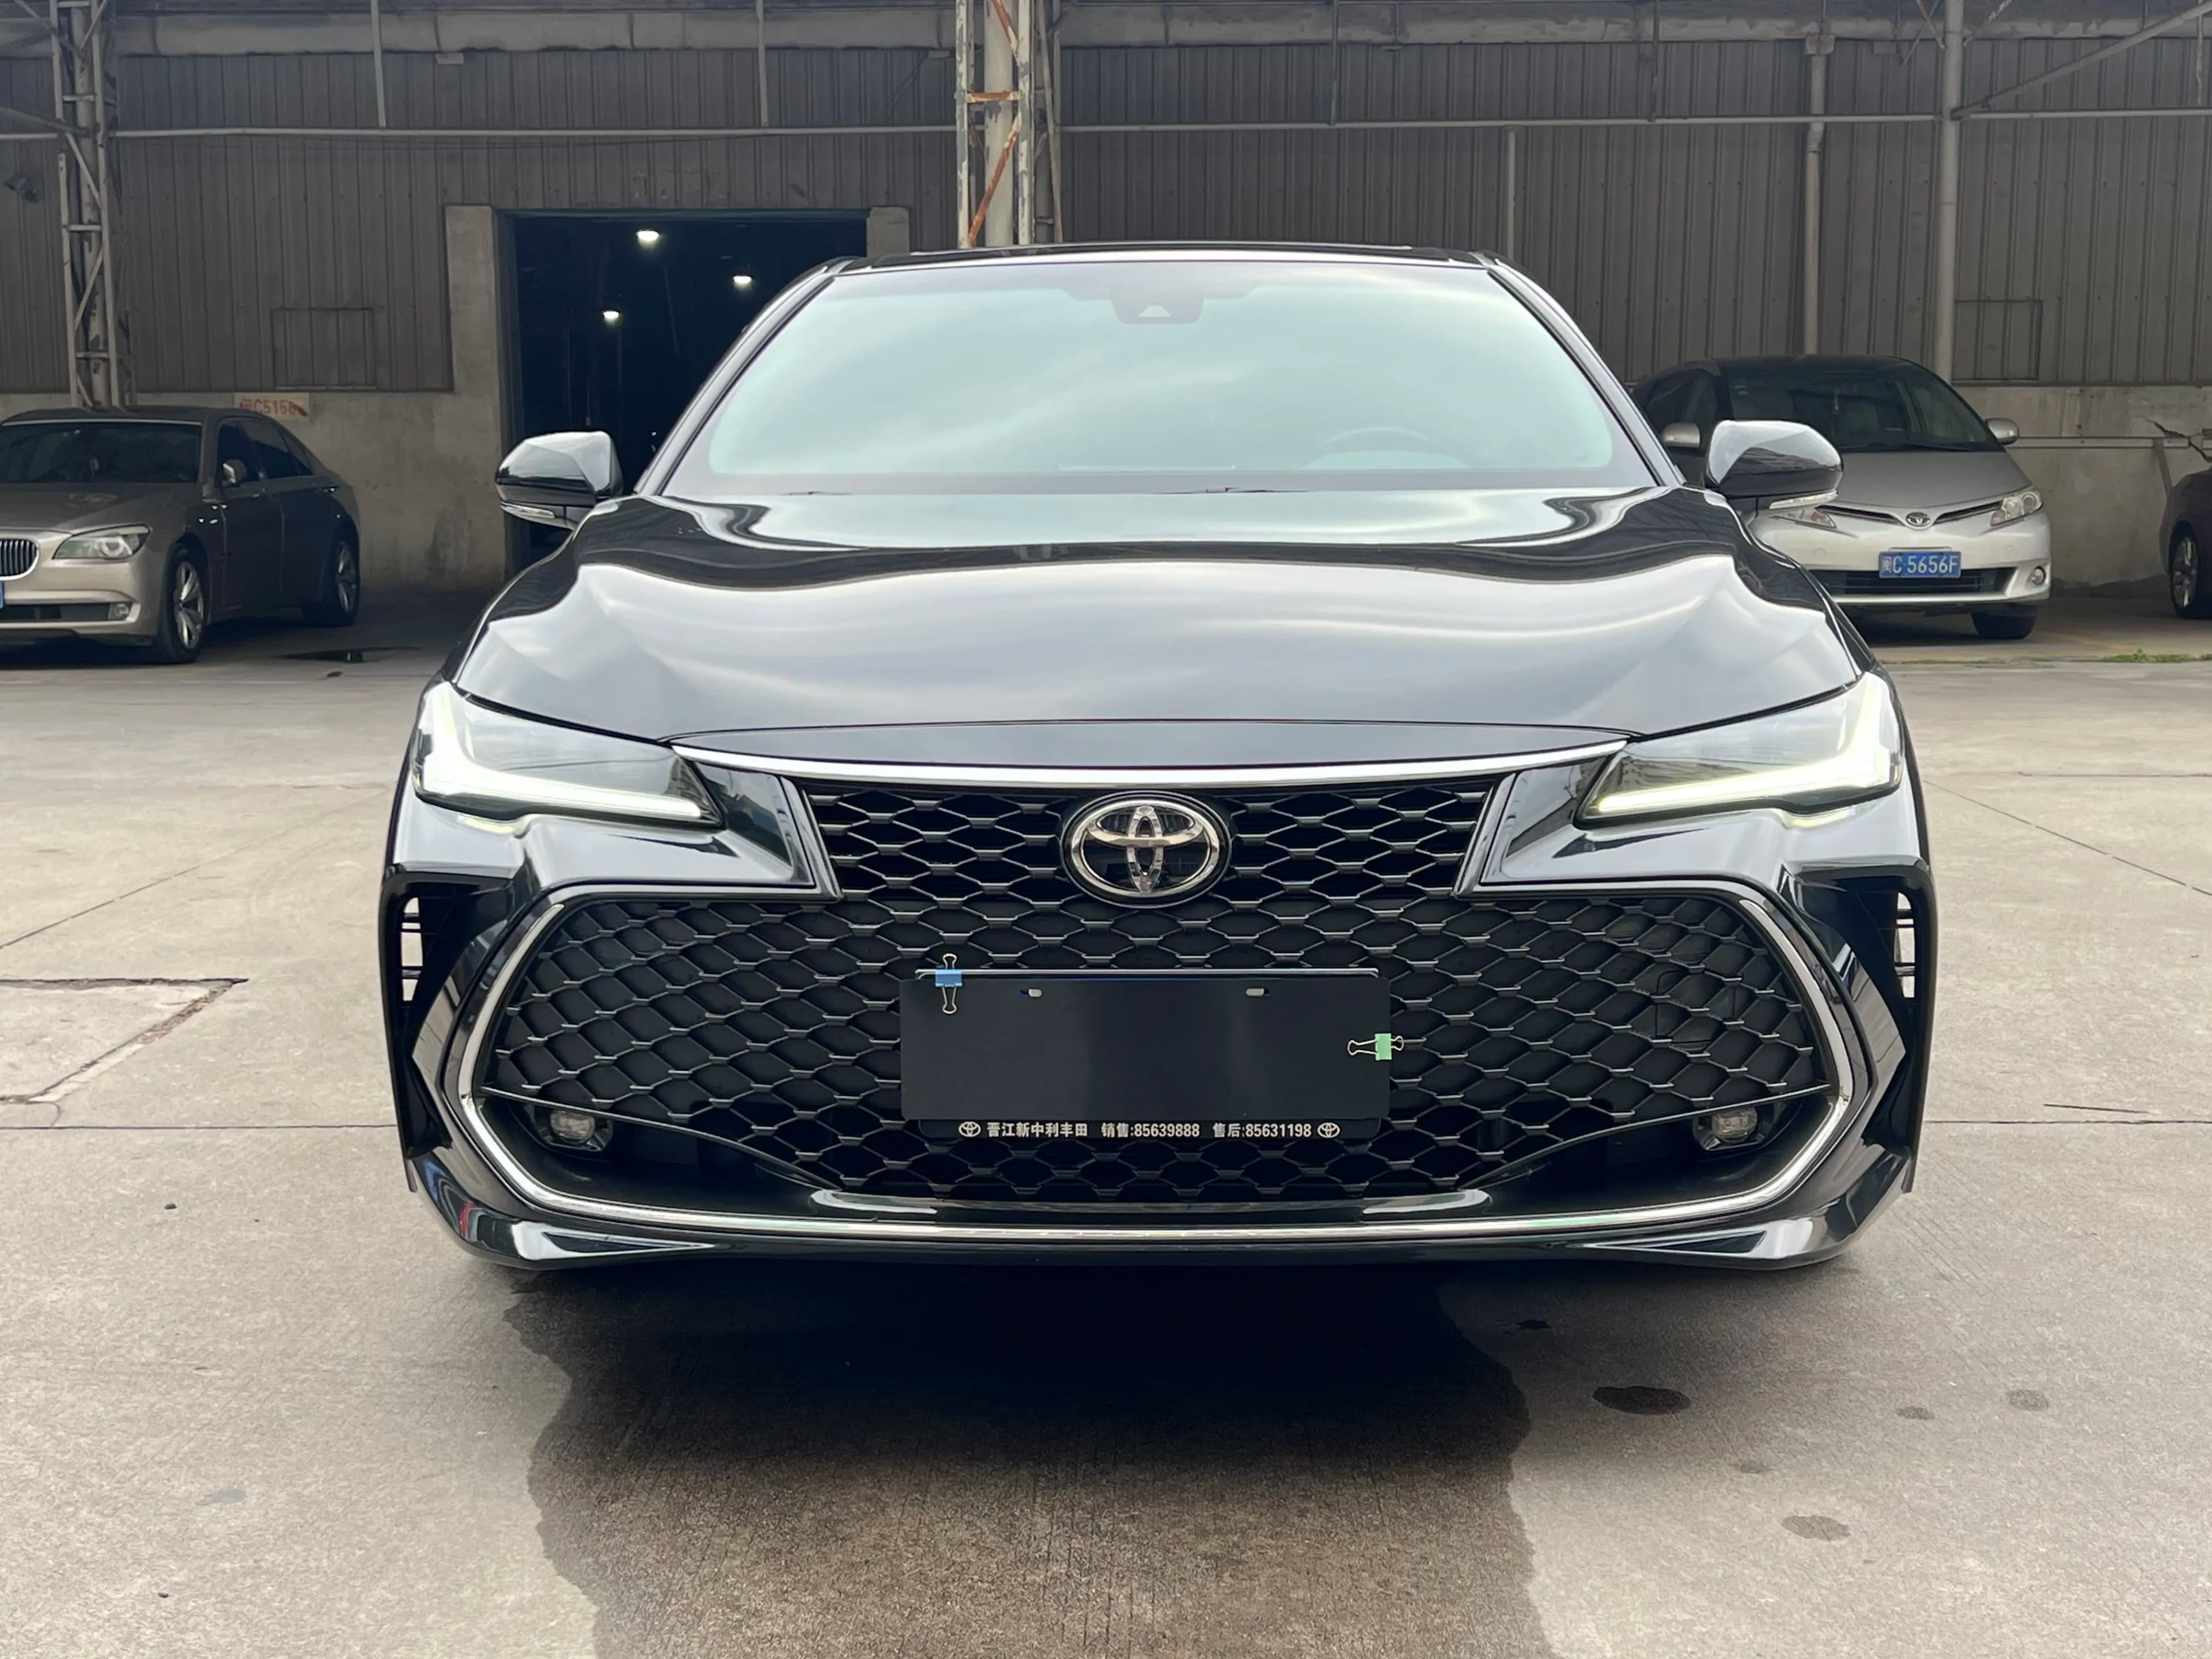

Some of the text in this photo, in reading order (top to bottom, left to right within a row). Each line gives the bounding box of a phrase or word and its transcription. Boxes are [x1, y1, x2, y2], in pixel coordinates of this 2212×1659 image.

[987, 1122, 1088, 1137] 晋江新中利丰田
